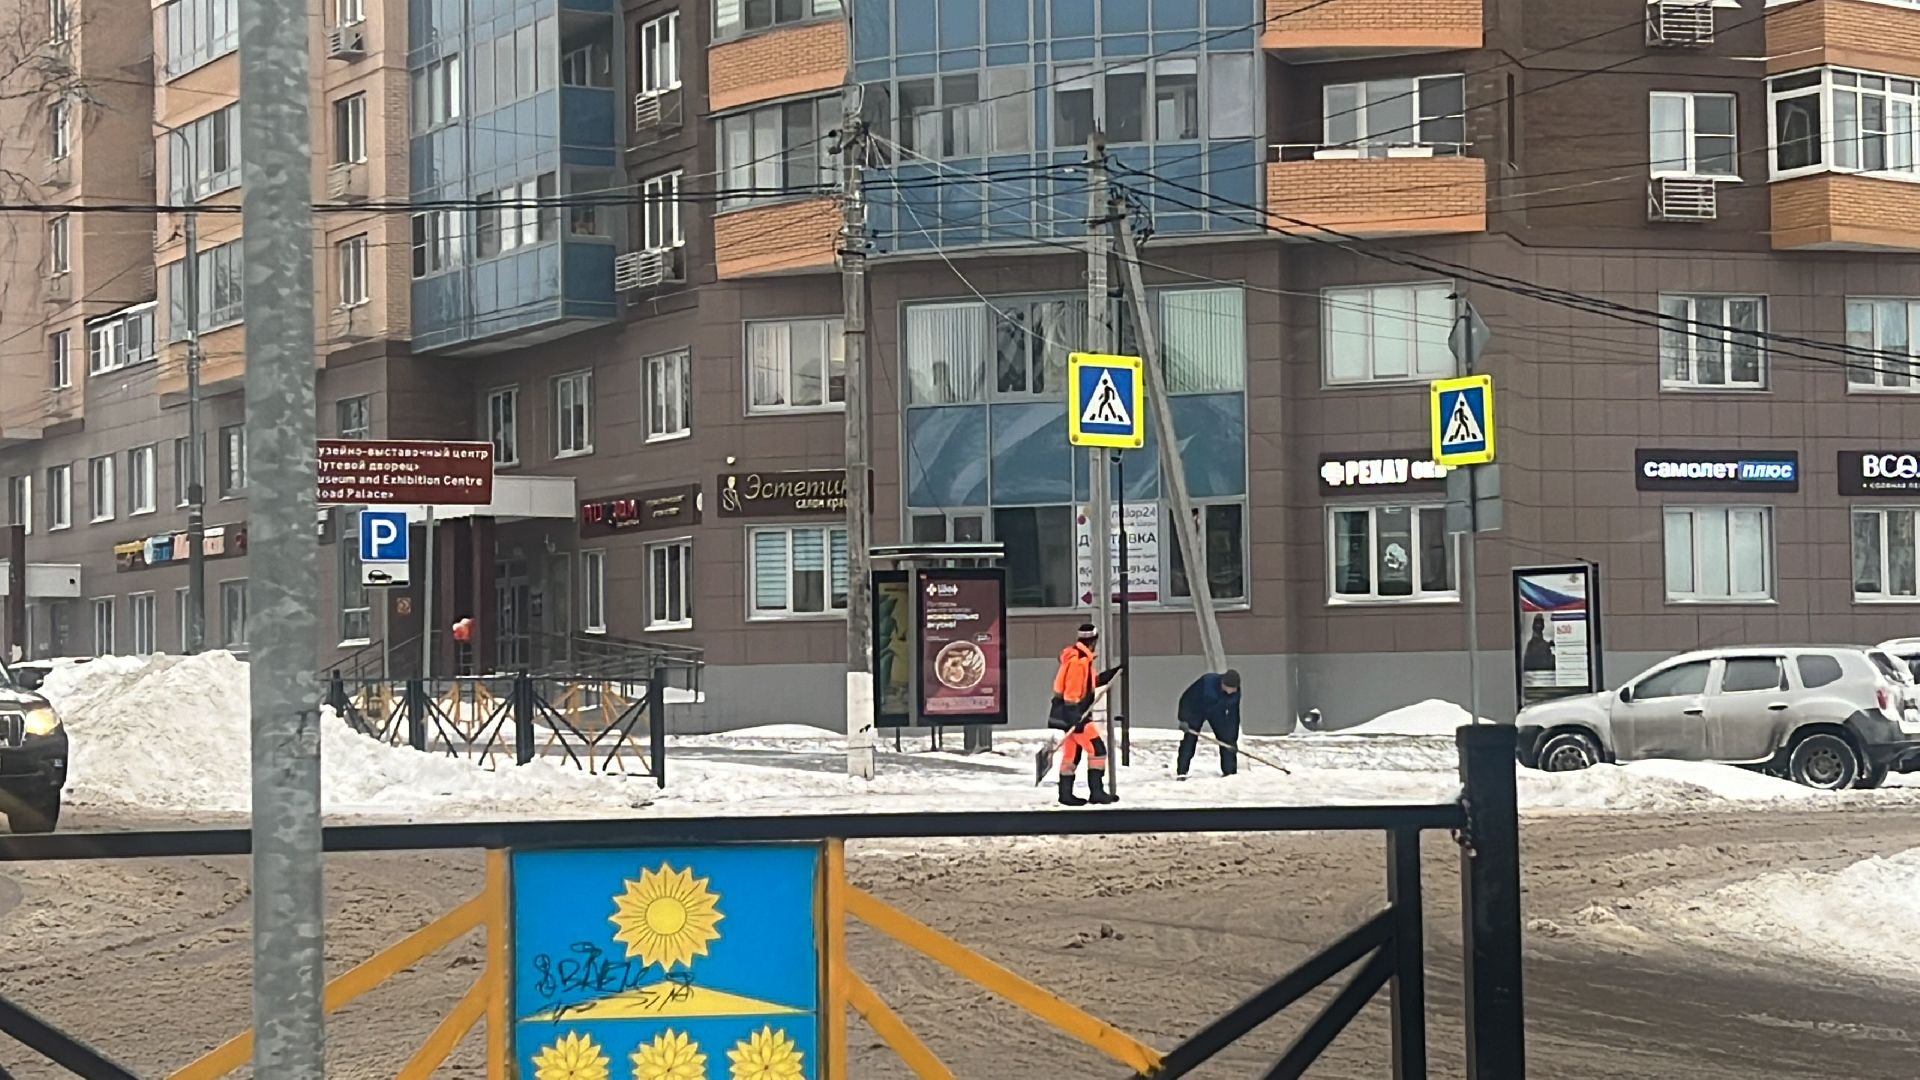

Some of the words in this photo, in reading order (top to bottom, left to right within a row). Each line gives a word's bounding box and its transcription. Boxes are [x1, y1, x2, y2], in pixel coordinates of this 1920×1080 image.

[318, 446, 450, 460] узейно-выставочный
[452, 450, 489, 461] центр
[317, 459, 366, 472] утевой
[317, 475, 356, 484] useum
[359, 475, 380, 485] and
[383, 475, 440, 486] Exhibition
[443, 475, 483, 487] Centre
[316, 487, 343, 499] oad
[346, 487, 394, 499] Palace»
[371, 519, 398, 558] P
[1078, 532, 1157, 547] ДТВКА
